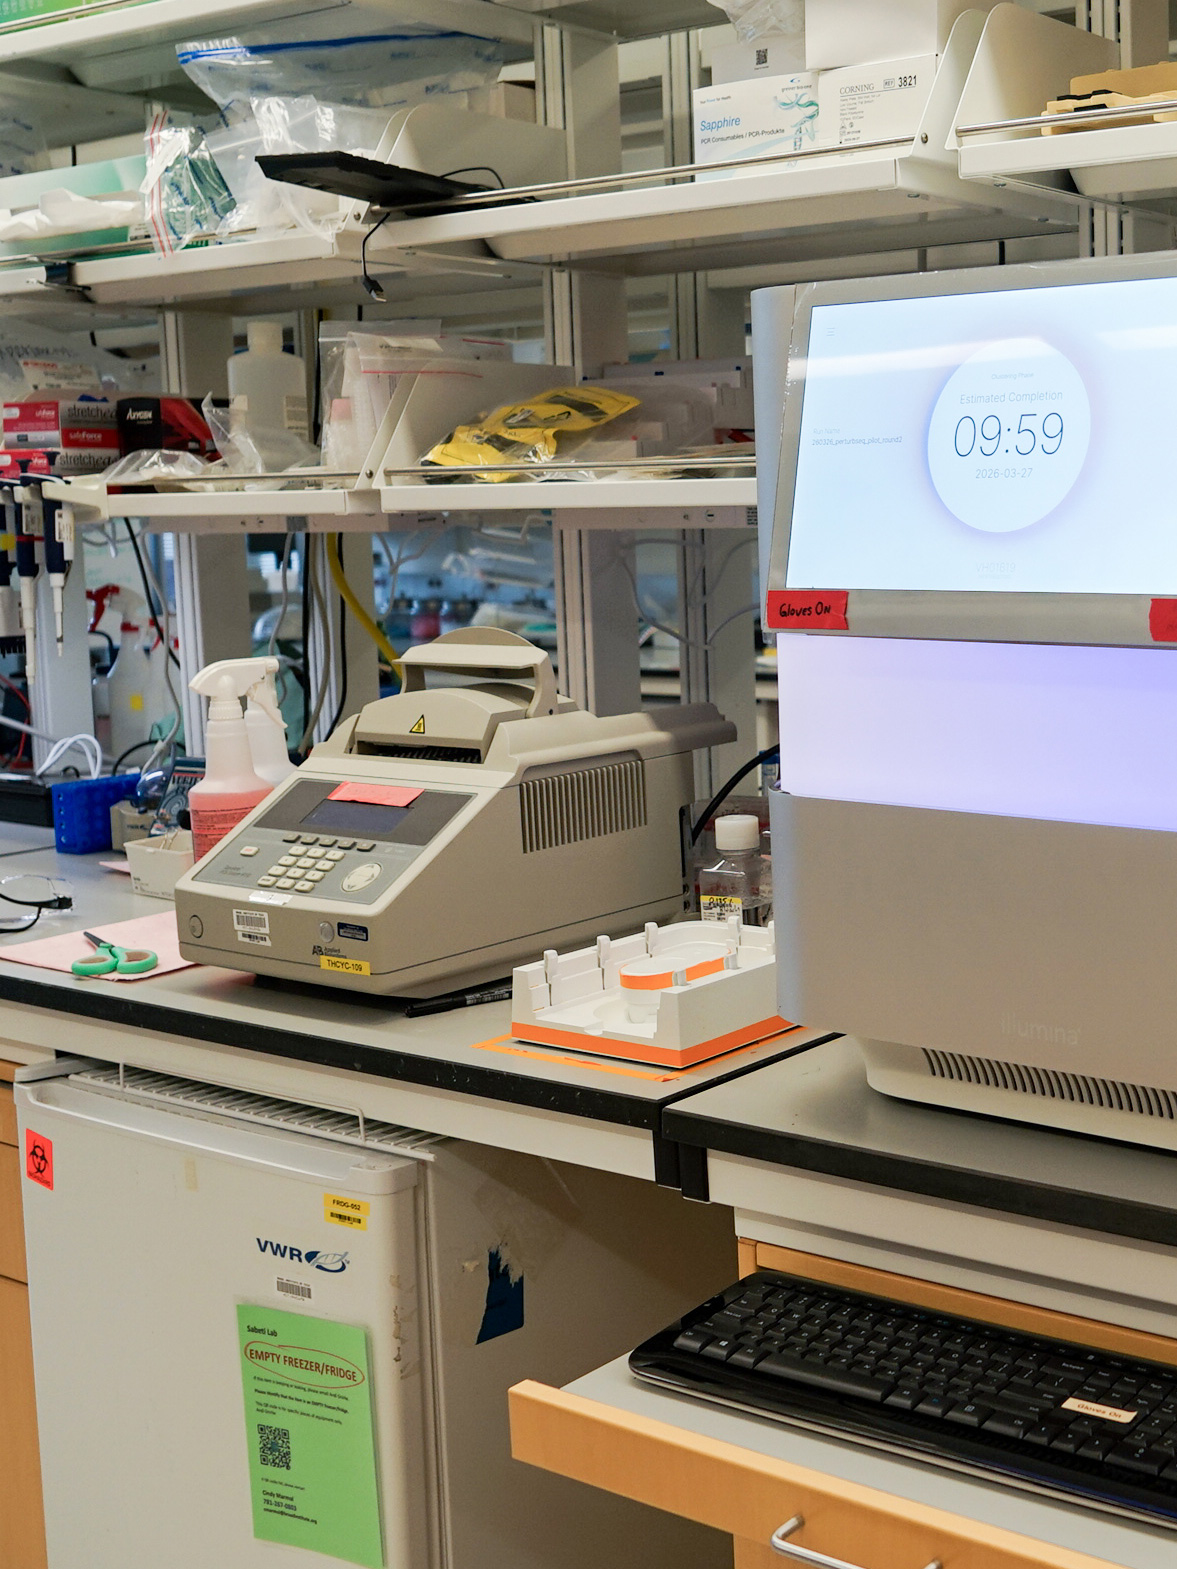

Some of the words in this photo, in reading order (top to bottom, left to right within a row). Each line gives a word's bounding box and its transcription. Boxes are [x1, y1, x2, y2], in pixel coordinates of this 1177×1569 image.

[898, 75, 916, 87] 3821
[840, 83, 874, 94] CORNING
[701, 116, 740, 132] Sapphire
[712, 134, 744, 143] Consumables
[748, 128, 784, 137] PCR-Produkte
[960, 393, 1006, 404] Estimated
[1008, 391, 1063, 404] Completion
[954, 412, 1064, 457] 09:59
[975, 468, 1033, 479] 2026-03-27
[780, 603, 812, 617] Gloves
[327, 959, 362, 971] THCYC-109
[256, 1238, 302, 1263] VWR
[247, 1325, 266, 1335] Sabeti
[250, 1349, 280, 1363] EMPTY
[284, 1355, 357, 1382] FREEZER/FRIDGE
[1078, 1404, 1106, 1414] Gloves
